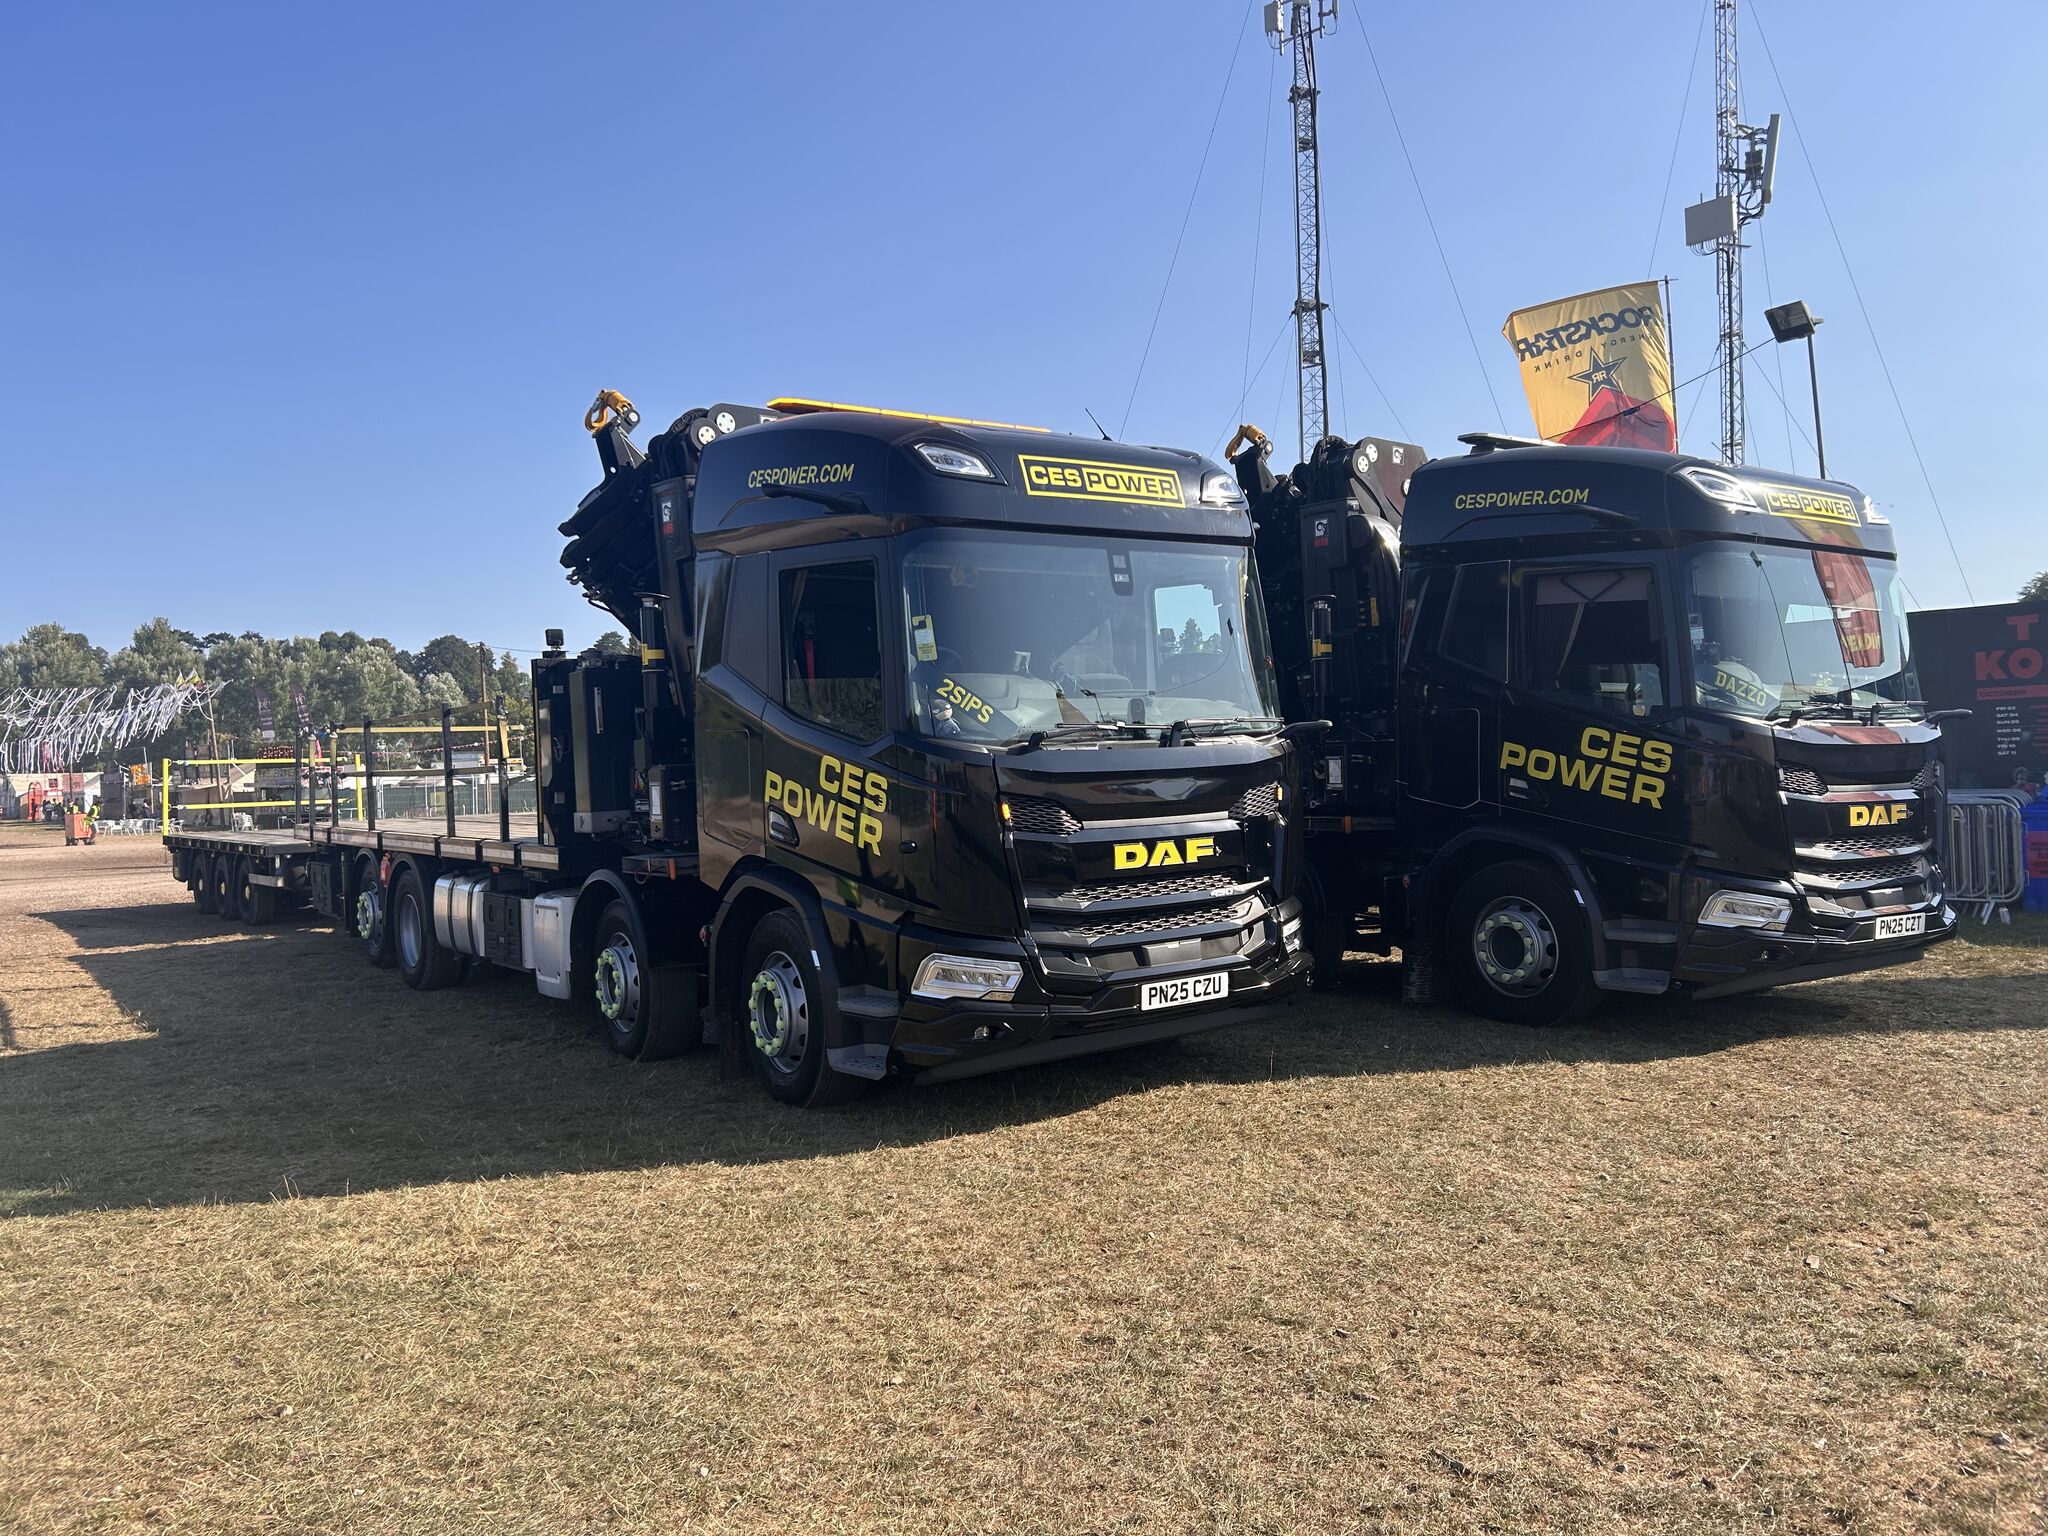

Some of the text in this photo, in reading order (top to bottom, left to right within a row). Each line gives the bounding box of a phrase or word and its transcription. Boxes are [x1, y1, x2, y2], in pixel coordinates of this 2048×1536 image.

[748, 463, 855, 489] CESPOWER.COM
[1455, 488, 1590, 510] CESPOWER.COM
[936, 679, 994, 723] 2SIPS
[1715, 671, 1767, 707] DAZZO
[1580, 726, 1673, 774] CES
[819, 754, 888, 813] CES
[1500, 741, 1665, 810] POWER
[764, 769, 883, 857] POWER
[1848, 803, 1907, 826] DAF
[1113, 836, 1214, 870] DAF
[1879, 915, 1922, 936] PN25 CZT
[1148, 976, 1222, 1006] PN25 CZU
